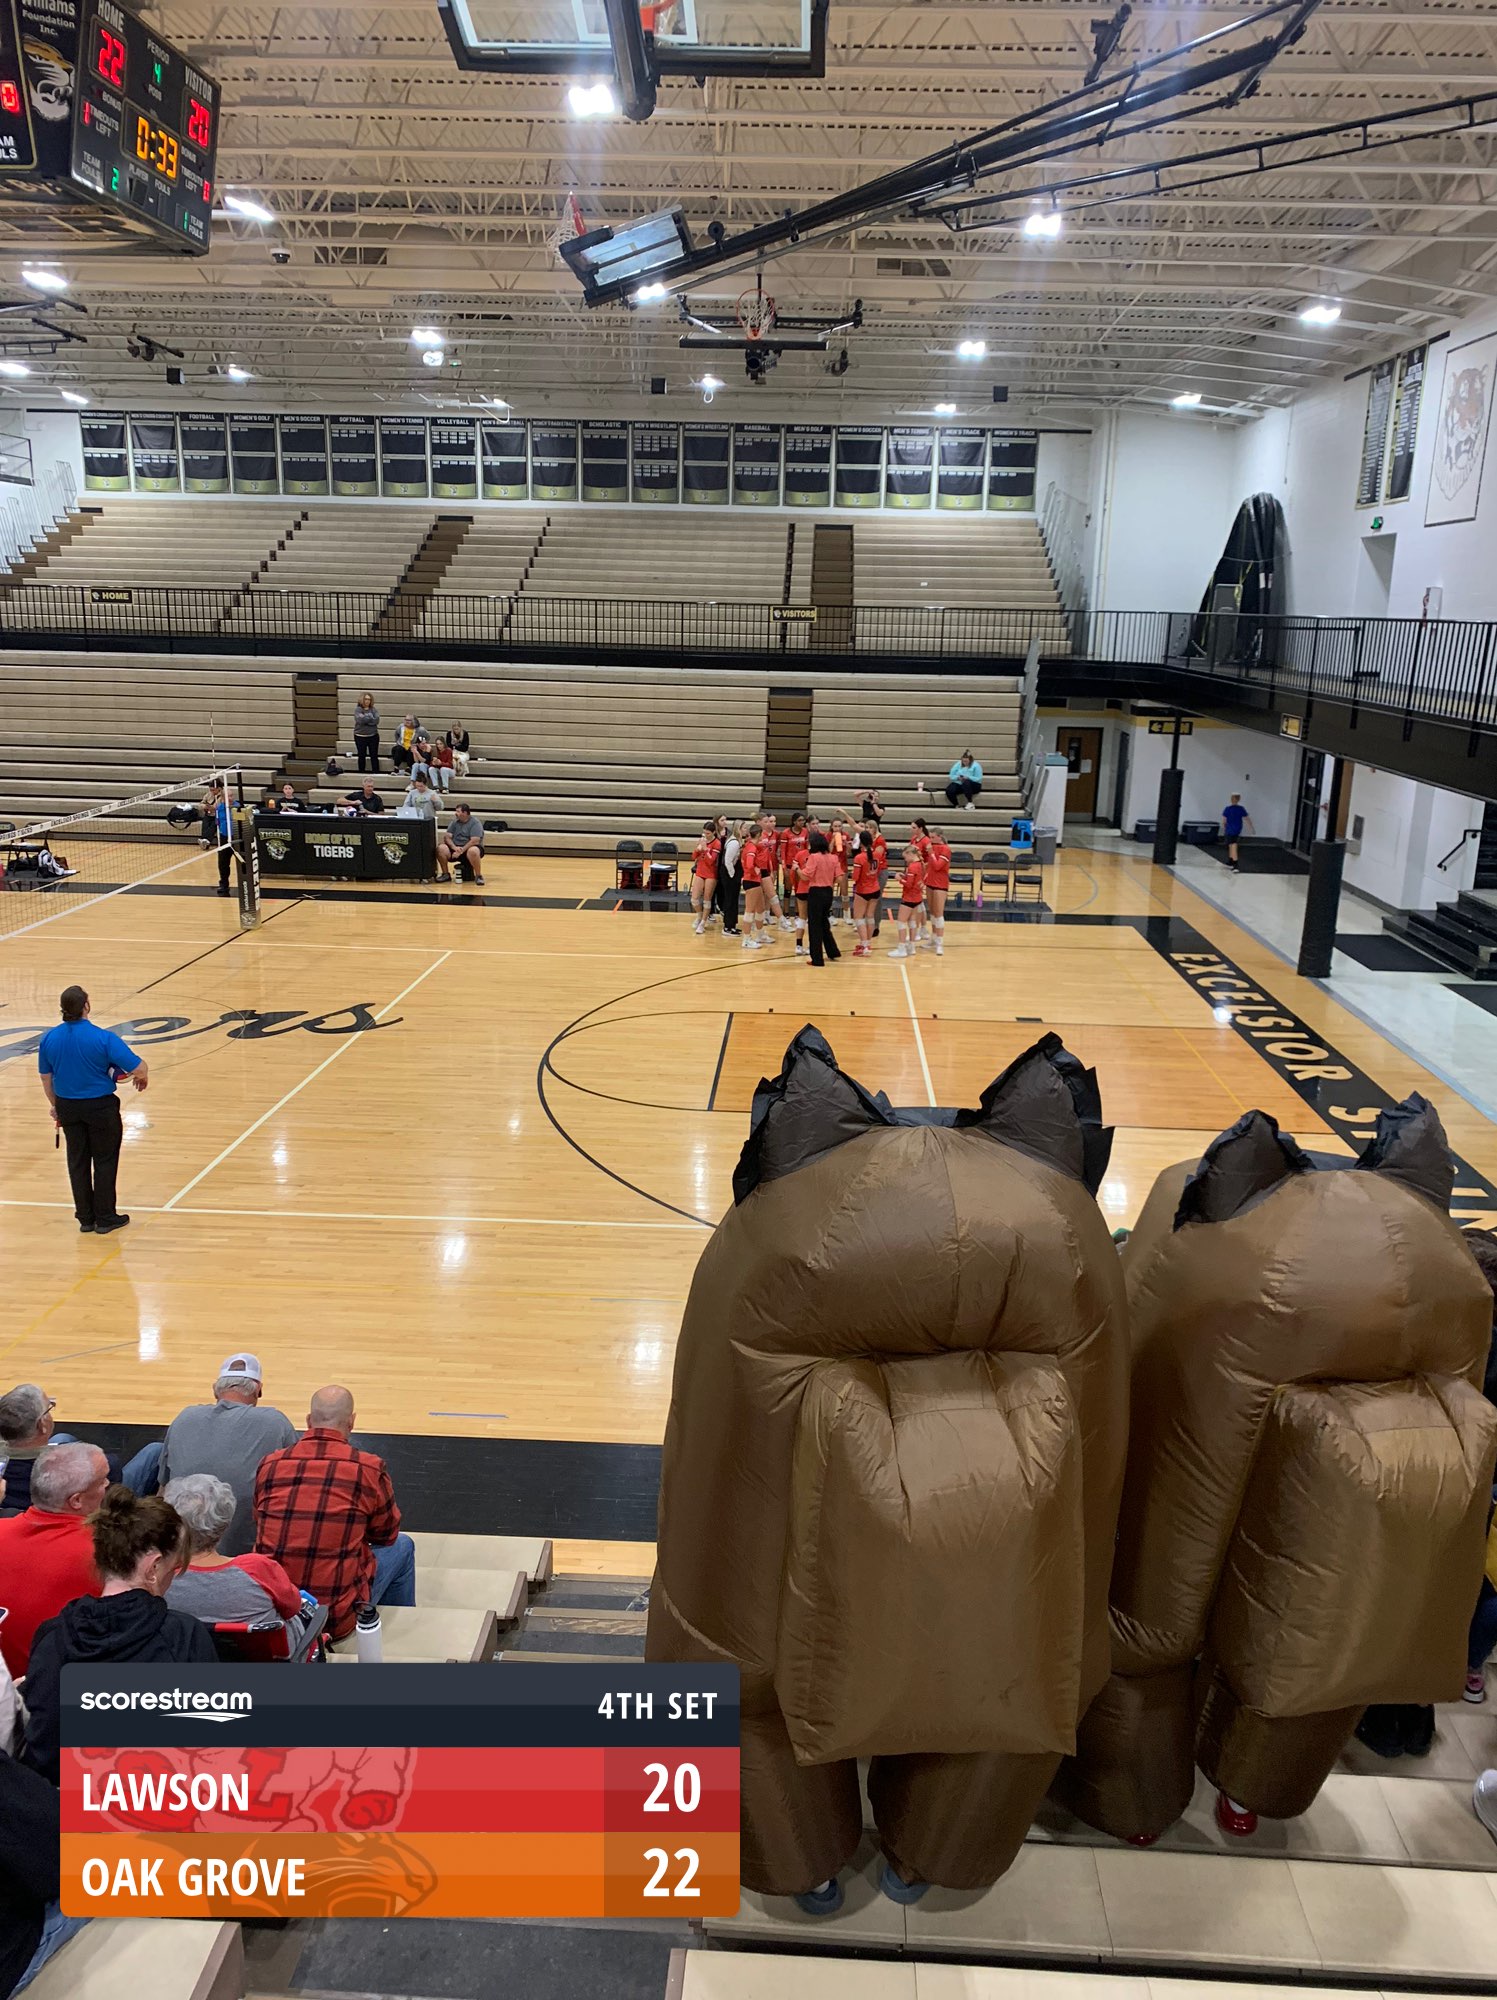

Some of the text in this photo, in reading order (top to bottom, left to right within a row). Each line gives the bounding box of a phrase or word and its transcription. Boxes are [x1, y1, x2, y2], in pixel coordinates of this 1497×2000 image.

[22, 9, 75, 29] Foundation
[97, 0, 125, 33] HOME
[40, 24, 58, 36] Inc.
[98, 28, 125, 88] 22
[154, 62, 161, 84] 4
[185, 65, 213, 104] VISITOR
[188, 97, 211, 148] 20
[136, 115, 179, 179] 0:33
[111, 166, 120, 191] 2
[102, 592, 129, 600] HOME
[782, 609, 815, 618] VISITORS
[0, 831, 16, 840] PRINGS
[260, 831, 291, 839] TIGERS
[305, 833, 362, 845] HOME OF THE
[376, 835, 409, 843] TIGERS
[313, 845, 354, 858] TIGERS
[1169, 952, 1353, 1081] EXCELSIOR
